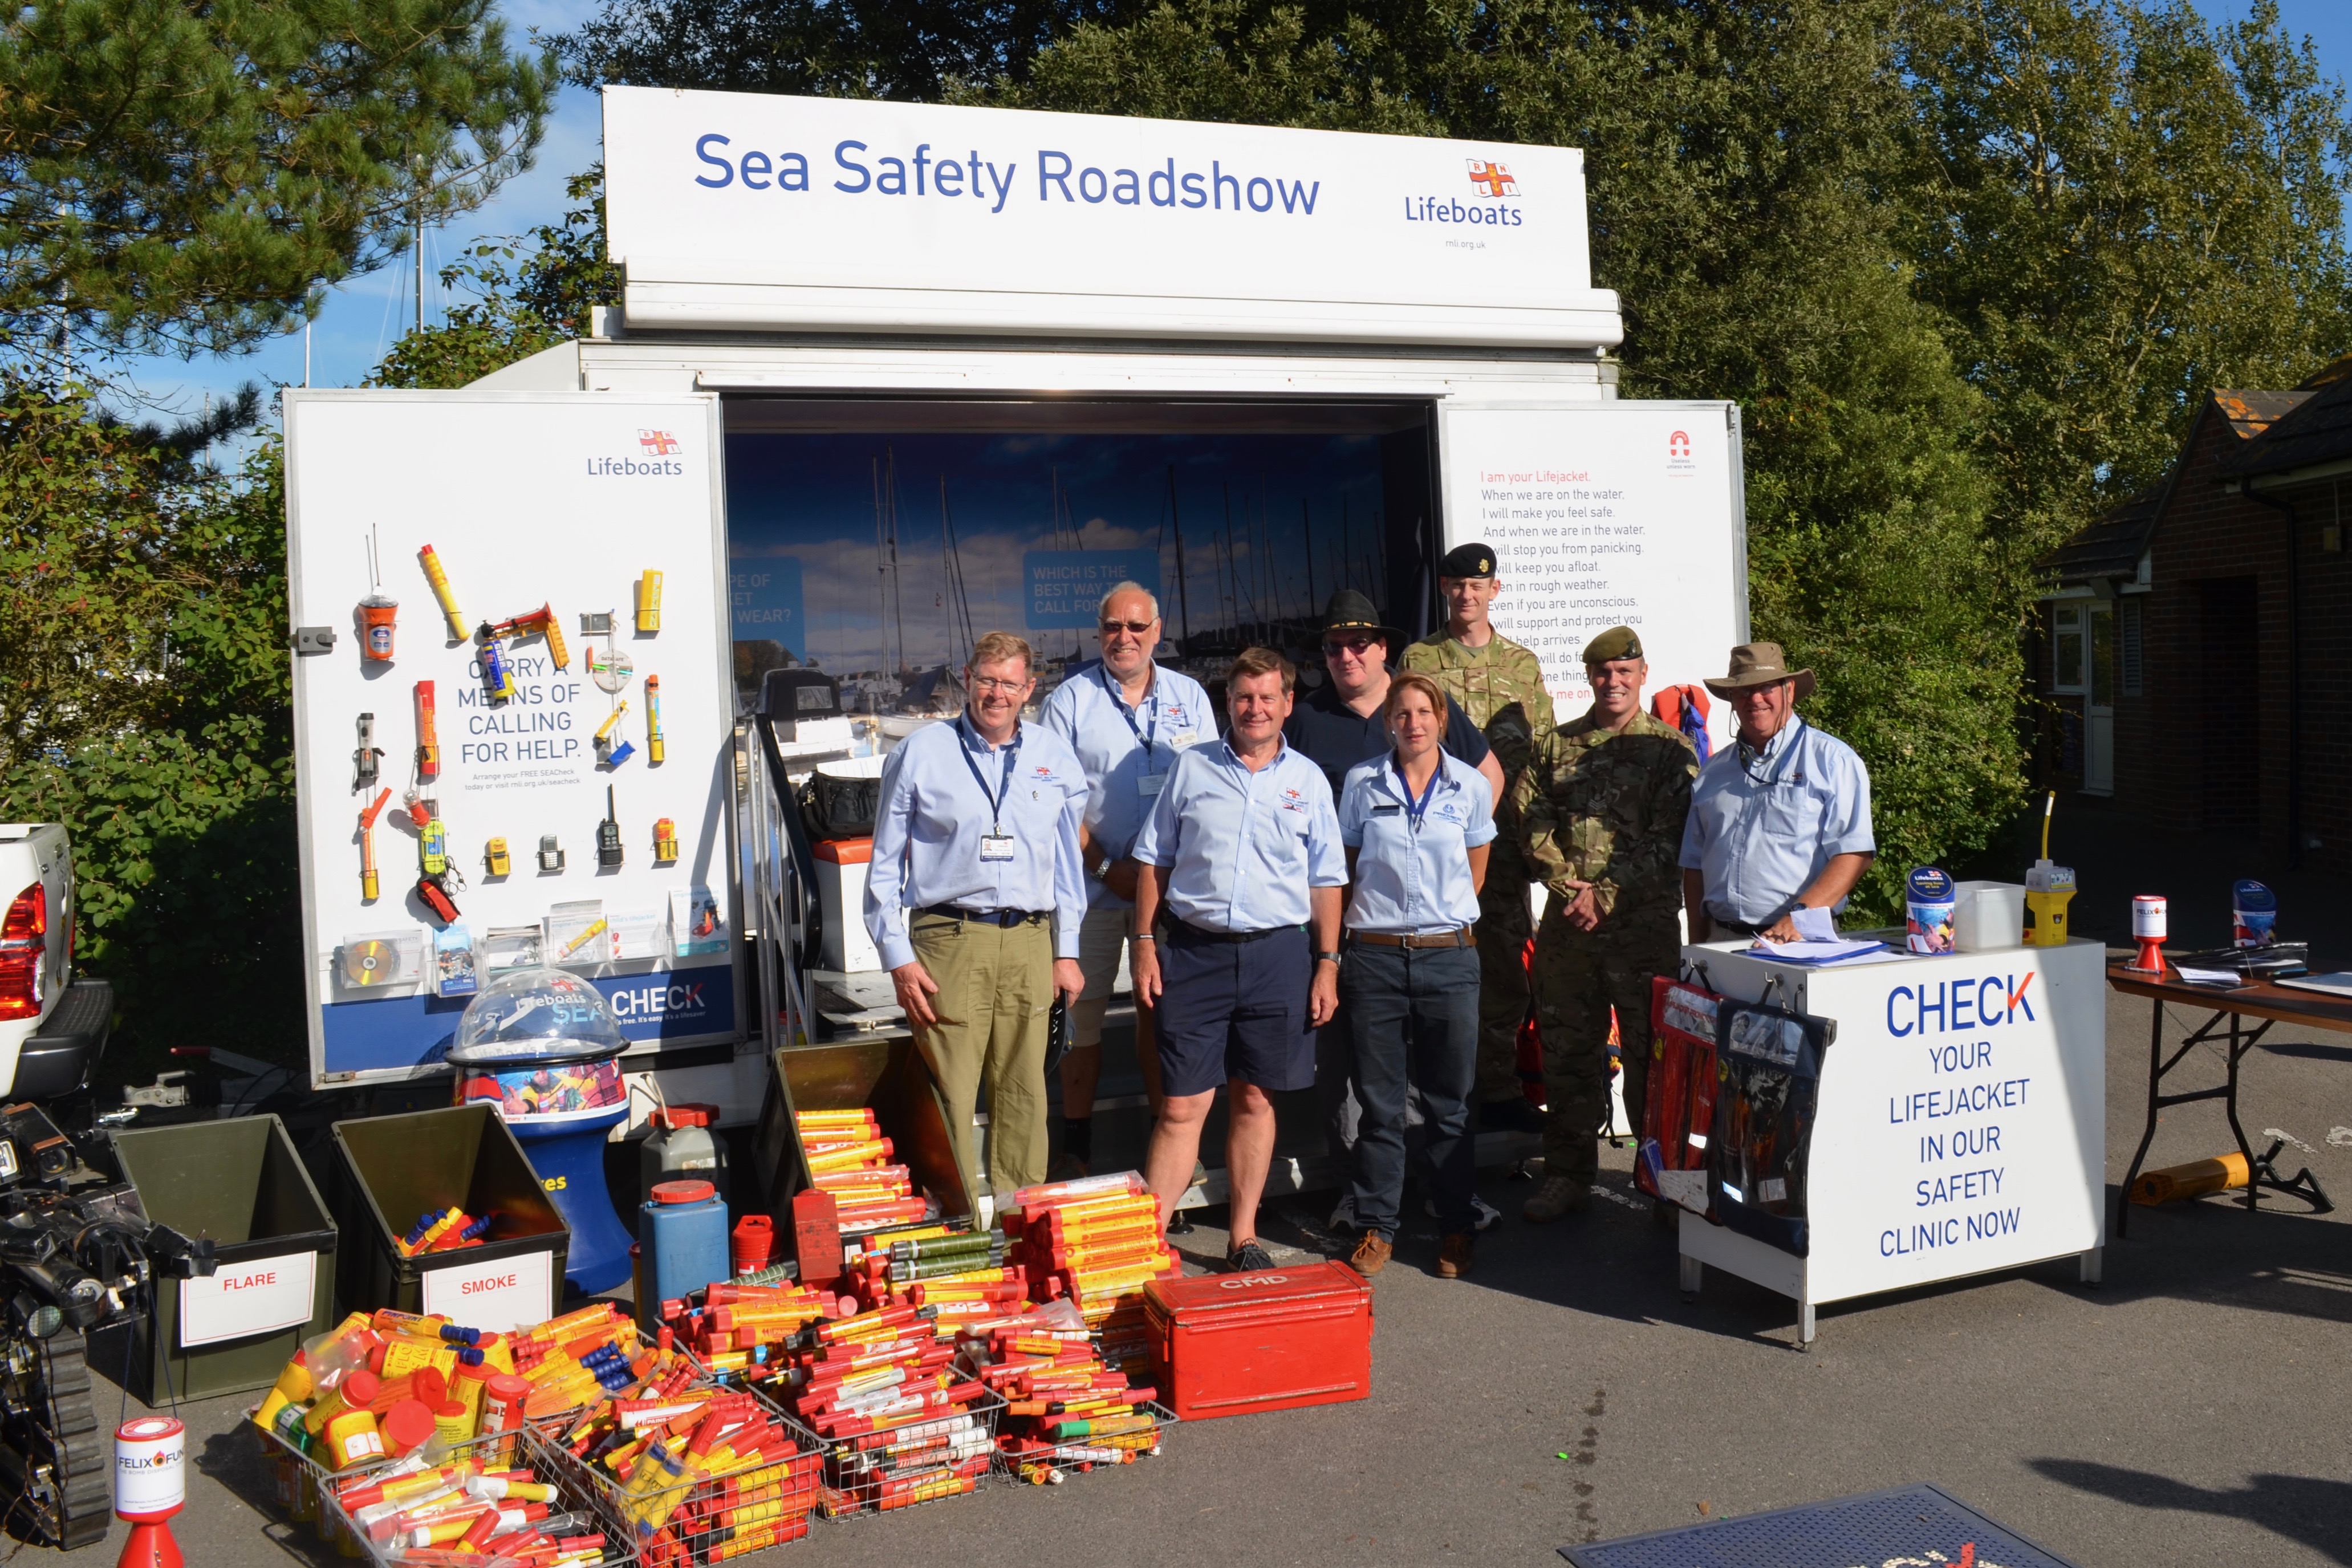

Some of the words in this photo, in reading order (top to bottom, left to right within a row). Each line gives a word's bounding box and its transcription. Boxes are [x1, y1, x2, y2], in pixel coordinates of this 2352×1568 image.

[694, 132, 810, 192] Sea
[834, 138, 1015, 214] Safety
[1038, 150, 1321, 217] Roadshow
[1473, 163, 1481, 171] R
[1479, 184, 1486, 194] L
[1405, 196, 1522, 226] Lifeboats
[1445, 239, 1486, 250] rnli.org.uk
[588, 457, 683, 475] Lifeboats
[1481, 471, 1484, 482] I
[1487, 473, 1505, 482] am
[1508, 472, 1533, 485] your
[1536, 470, 1591, 485] Lifejacket.
[1481, 489, 1513, 501] When
[1517, 491, 1532, 500] we
[1536, 491, 1553, 500] are
[1557, 490, 1569, 499] on
[1573, 489, 1590, 499] the
[1482, 508, 1485, 519] I
[1489, 507, 1509, 519] will
[1512, 507, 1542, 518] make
[1545, 509, 1565, 521] you
[1568, 507, 1587, 518] feel
[1590, 506, 1615, 518] safe.
[1484, 526, 1505, 537] And
[1508, 525, 1538, 537] when
[1542, 527, 1557, 536] we
[1561, 526, 1578, 535] are
[1582, 525, 1591, 535] in
[1594, 525, 1611, 535] the
[1513, 545, 1537, 557] stop
[1539, 545, 1558, 558] you
[1562, 543, 1587, 554] from
[1591, 542, 1644, 556] panicking.
[1033, 567, 1080, 580] WHICH
[1084, 566, 1096, 578] IS
[1100, 565, 1127, 578] THE
[1516, 562, 1542, 575] keep
[1546, 563, 1565, 576] you
[1568, 561, 1601, 572] afloat.
[751, 574, 771, 587] OF
[1517, 581, 1526, 591] in
[1530, 580, 1561, 594] rough
[1564, 579, 1610, 591] weather.
[1034, 584, 1069, 596] BEST
[1074, 583, 1102, 595] WAY
[1035, 602, 1070, 614] CALL
[1074, 600, 1099, 612] FOR
[1488, 600, 1513, 611] Even
[1517, 599, 1524, 610] if
[1527, 600, 1545, 612] you
[1549, 599, 1566, 609] are
[737, 608, 791, 623] WEAR?
[1494, 618, 1513, 629] will
[1517, 616, 1558, 630] support
[1562, 615, 1582, 627] and
[1585, 614, 1620, 629] protect
[1624, 615, 1642, 627] you
[1516, 636, 1539, 648] help
[1543, 634, 1583, 645] arrives.
[1538, 653, 1555, 664] will
[1559, 652, 1572, 663] do
[469, 657, 545, 680] CRRY
[551, 683, 580, 704] OF
[1557, 690, 1574, 700] me
[1577, 689, 1593, 699] on.
[469, 712, 571, 735] CALLING
[462, 742, 509, 763] FOR
[517, 738, 580, 761] HELP.
[611, 983, 705, 1016] CHECK
[1887, 972, 2036, 1038] CHECK
[1929, 1041, 1992, 1074] YOUR
[1890, 1079, 2031, 1124] LIFEJACKET
[1920, 1135, 1944, 1163] IN
[1953, 1126, 2001, 1157] OUR
[1916, 1168, 2004, 1207] SAFETY
[1880, 1219, 1959, 1257] CLINIC
[1967, 1207, 2021, 1240] NOW
[224, 1272, 276, 1291] FLARE
[461, 1274, 517, 1295] SMOKE
[1220, 1274, 1287, 1290] CMD
[119, 1457, 152, 1468] FELIX
[147, 1465, 174, 1474] DISPOSAL
